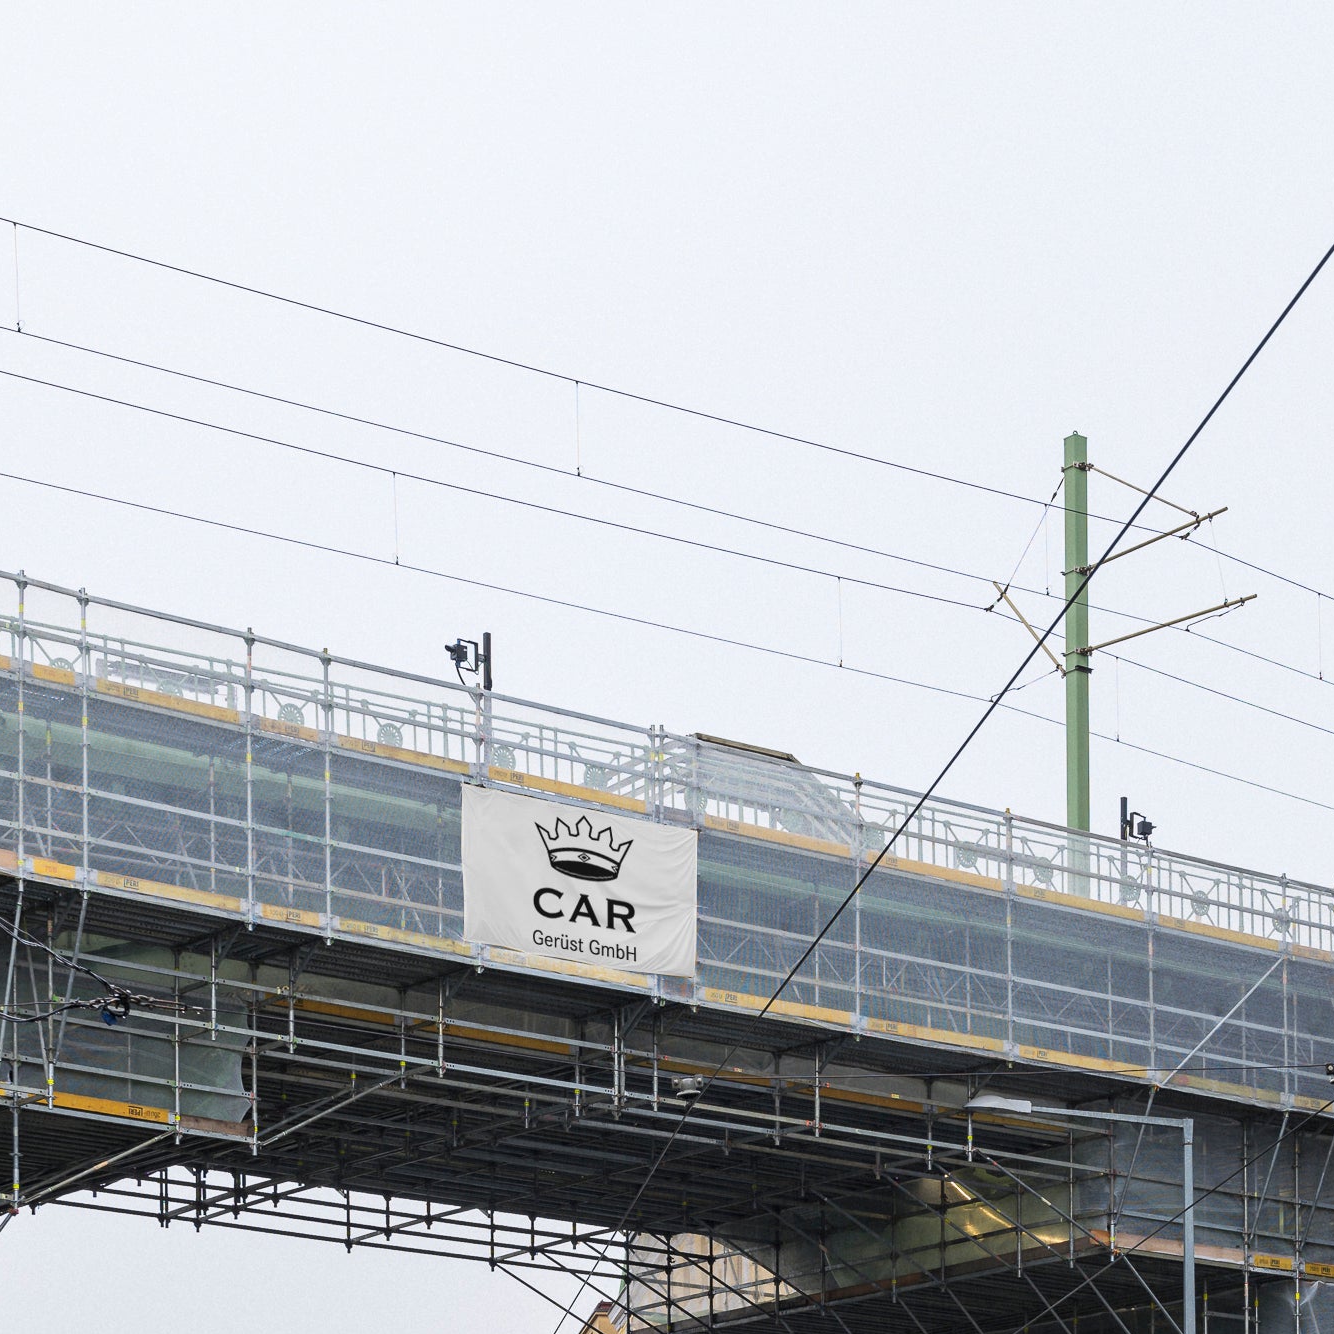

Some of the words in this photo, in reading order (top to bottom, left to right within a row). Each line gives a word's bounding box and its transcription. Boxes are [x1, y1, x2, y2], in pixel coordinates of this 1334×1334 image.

[533, 887, 636, 934] CAR
[533, 930, 584, 953] Gerüst
[589, 939, 637, 962] GmbH
